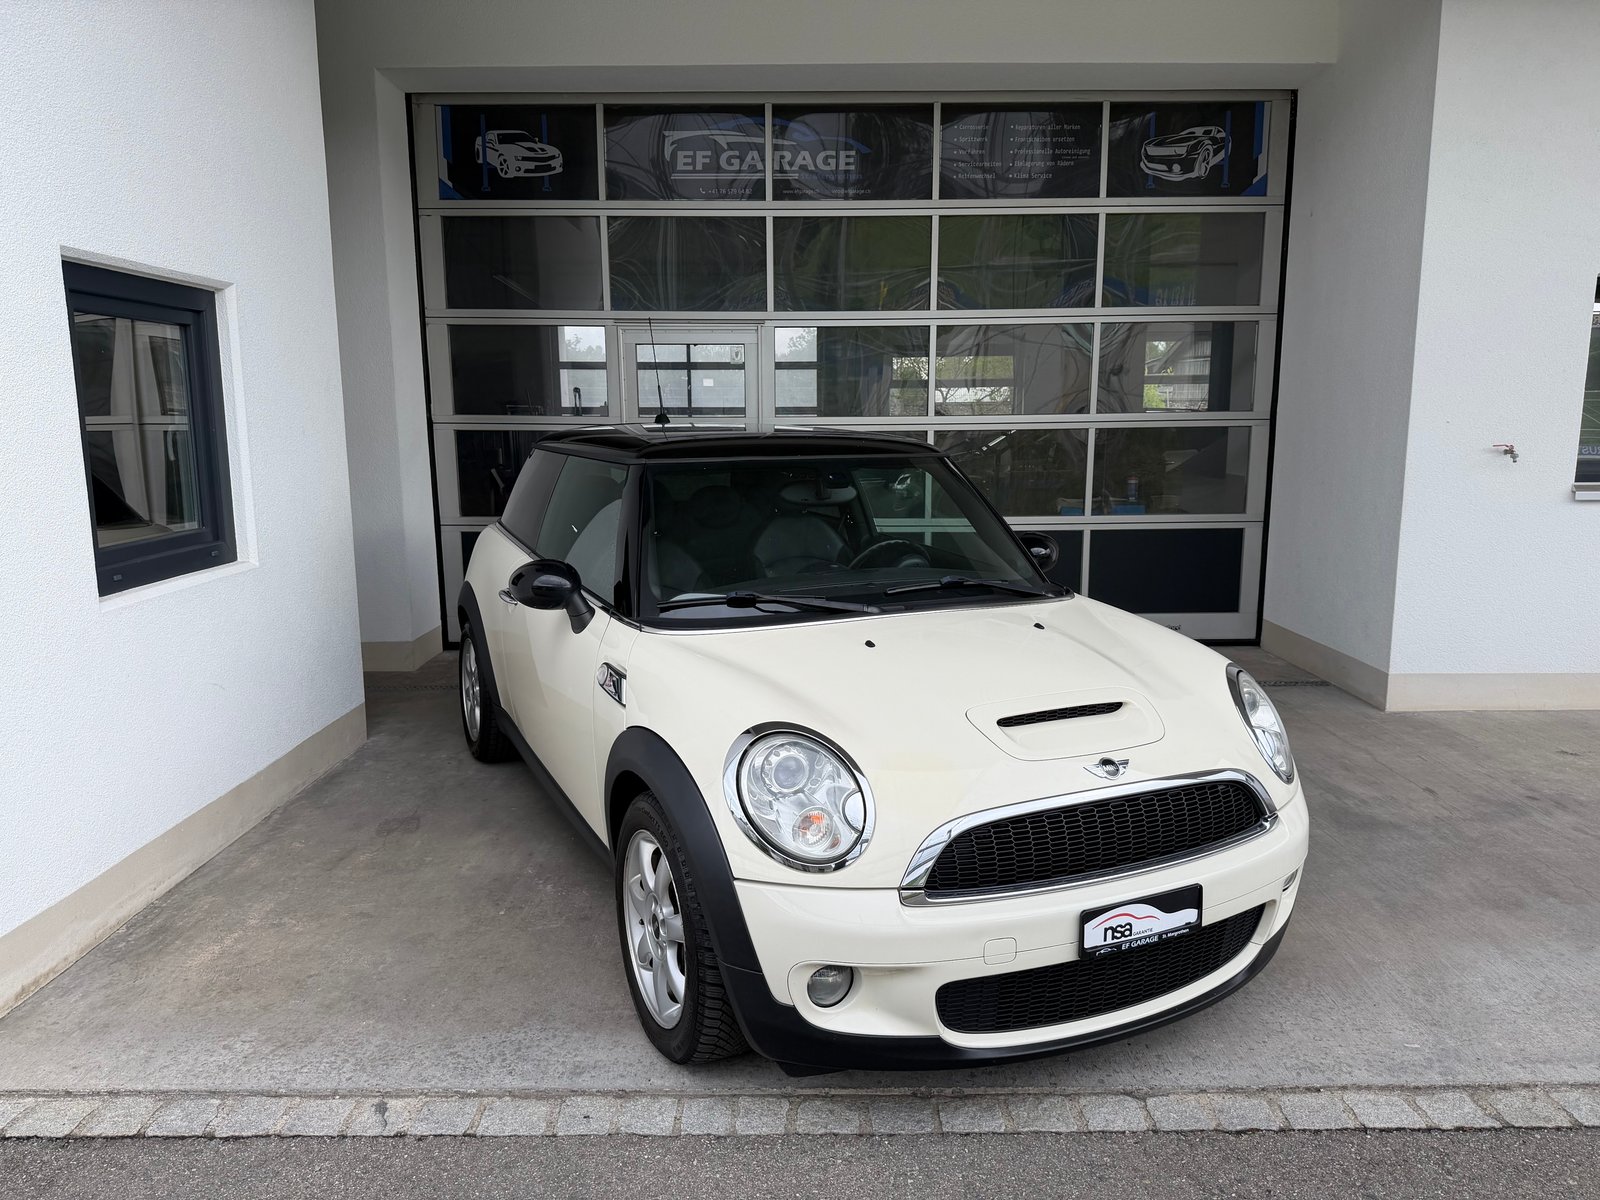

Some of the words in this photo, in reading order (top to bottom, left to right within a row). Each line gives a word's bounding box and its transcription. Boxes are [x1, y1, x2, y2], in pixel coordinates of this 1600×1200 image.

[676, 150, 712, 171] EF
[719, 150, 857, 171] GARAGE
[1103, 922, 1133, 942] nsa
[1132, 927, 1153, 937] GARANTIE
[1121, 942, 1131, 950] EF
[1130, 934, 1160, 948] GARAGE
